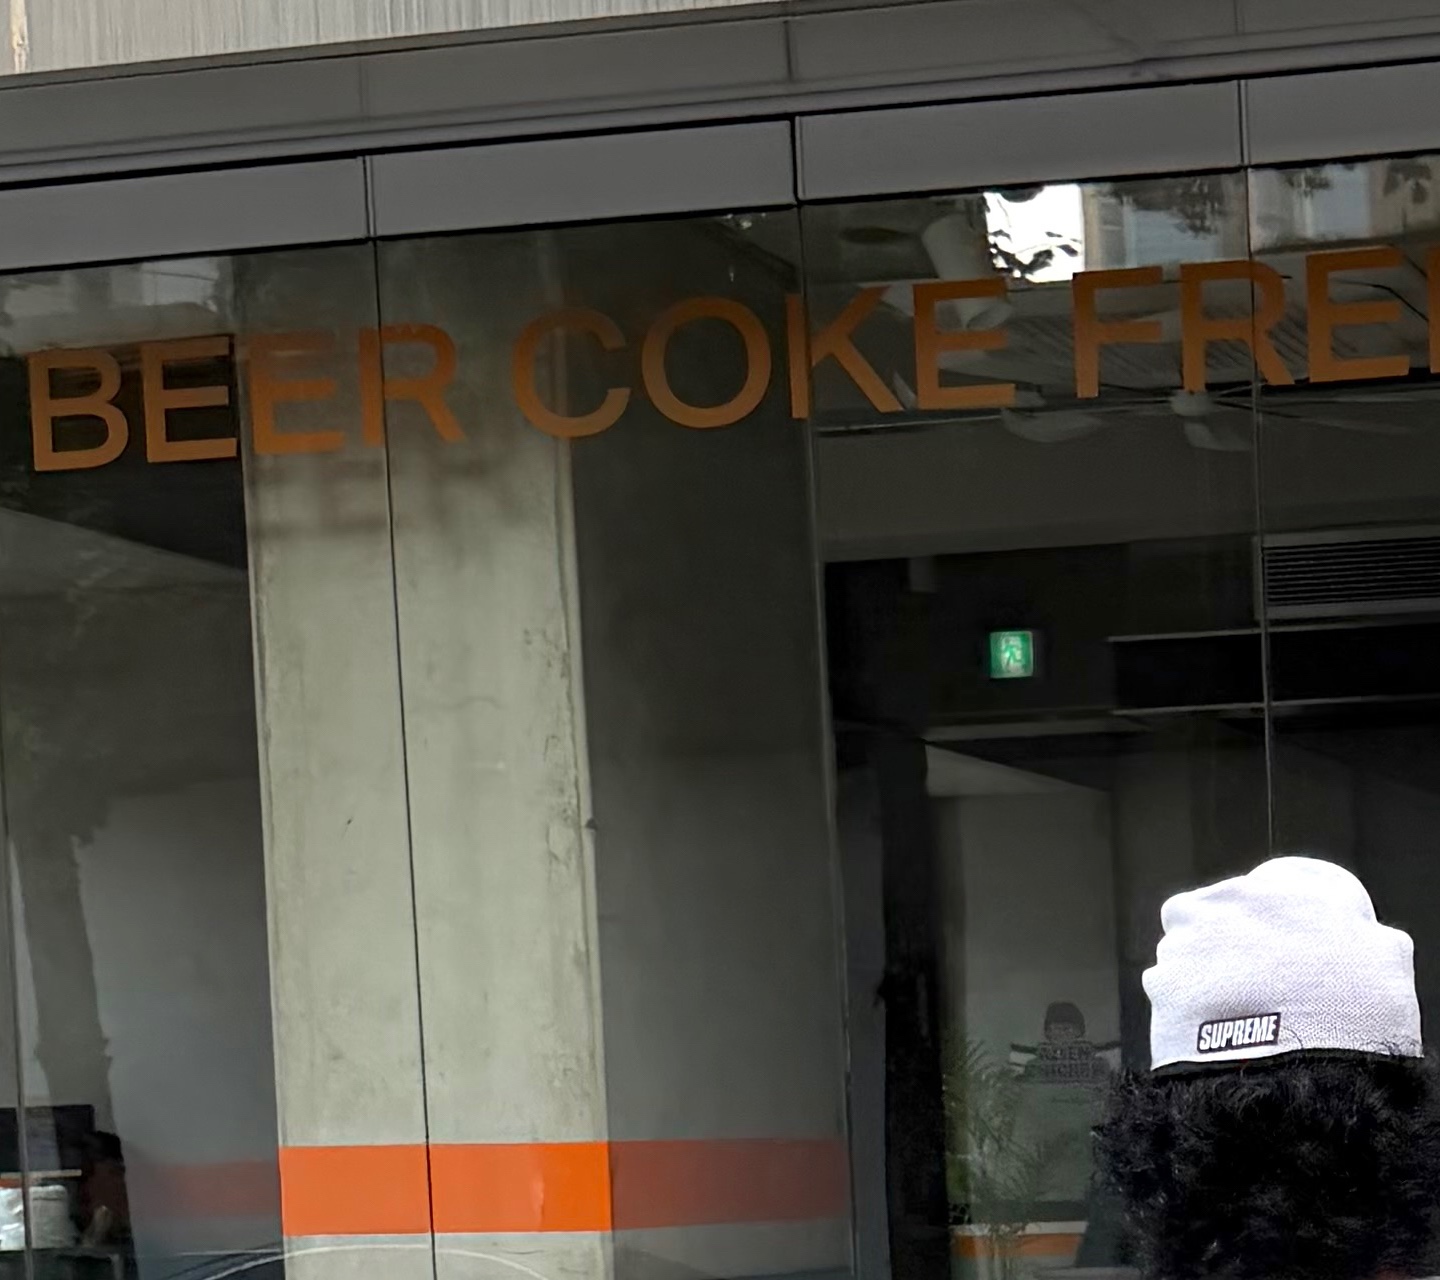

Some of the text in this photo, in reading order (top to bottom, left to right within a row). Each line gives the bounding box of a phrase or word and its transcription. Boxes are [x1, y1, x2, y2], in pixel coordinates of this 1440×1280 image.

[27, 322, 466, 472] BEER
[511, 277, 1016, 440] COKE
[1199, 1015, 1278, 1051] SUPREME
